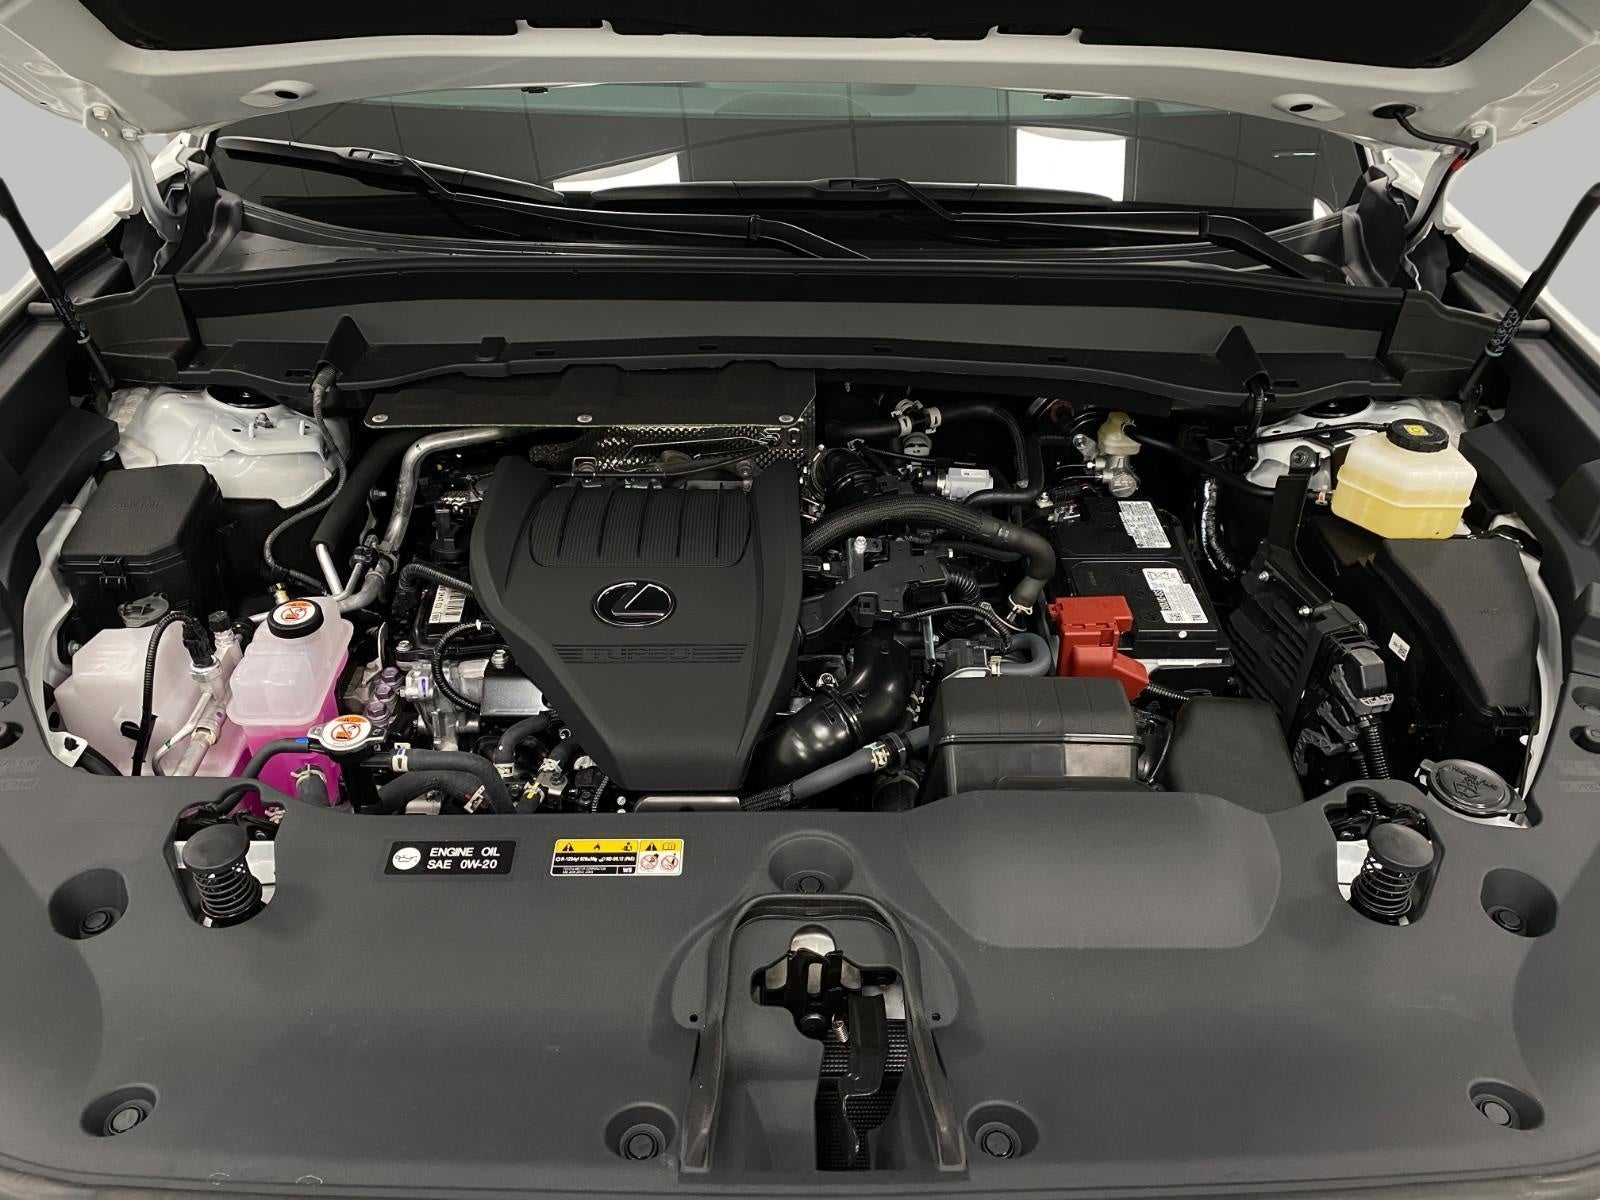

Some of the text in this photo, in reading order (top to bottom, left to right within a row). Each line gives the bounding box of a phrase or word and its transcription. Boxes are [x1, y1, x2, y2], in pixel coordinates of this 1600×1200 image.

[583, 646, 693, 661] TURBO
[430, 846, 501, 857] ENGINE OIL
[427, 860, 498, 870] SAE 0W-20
